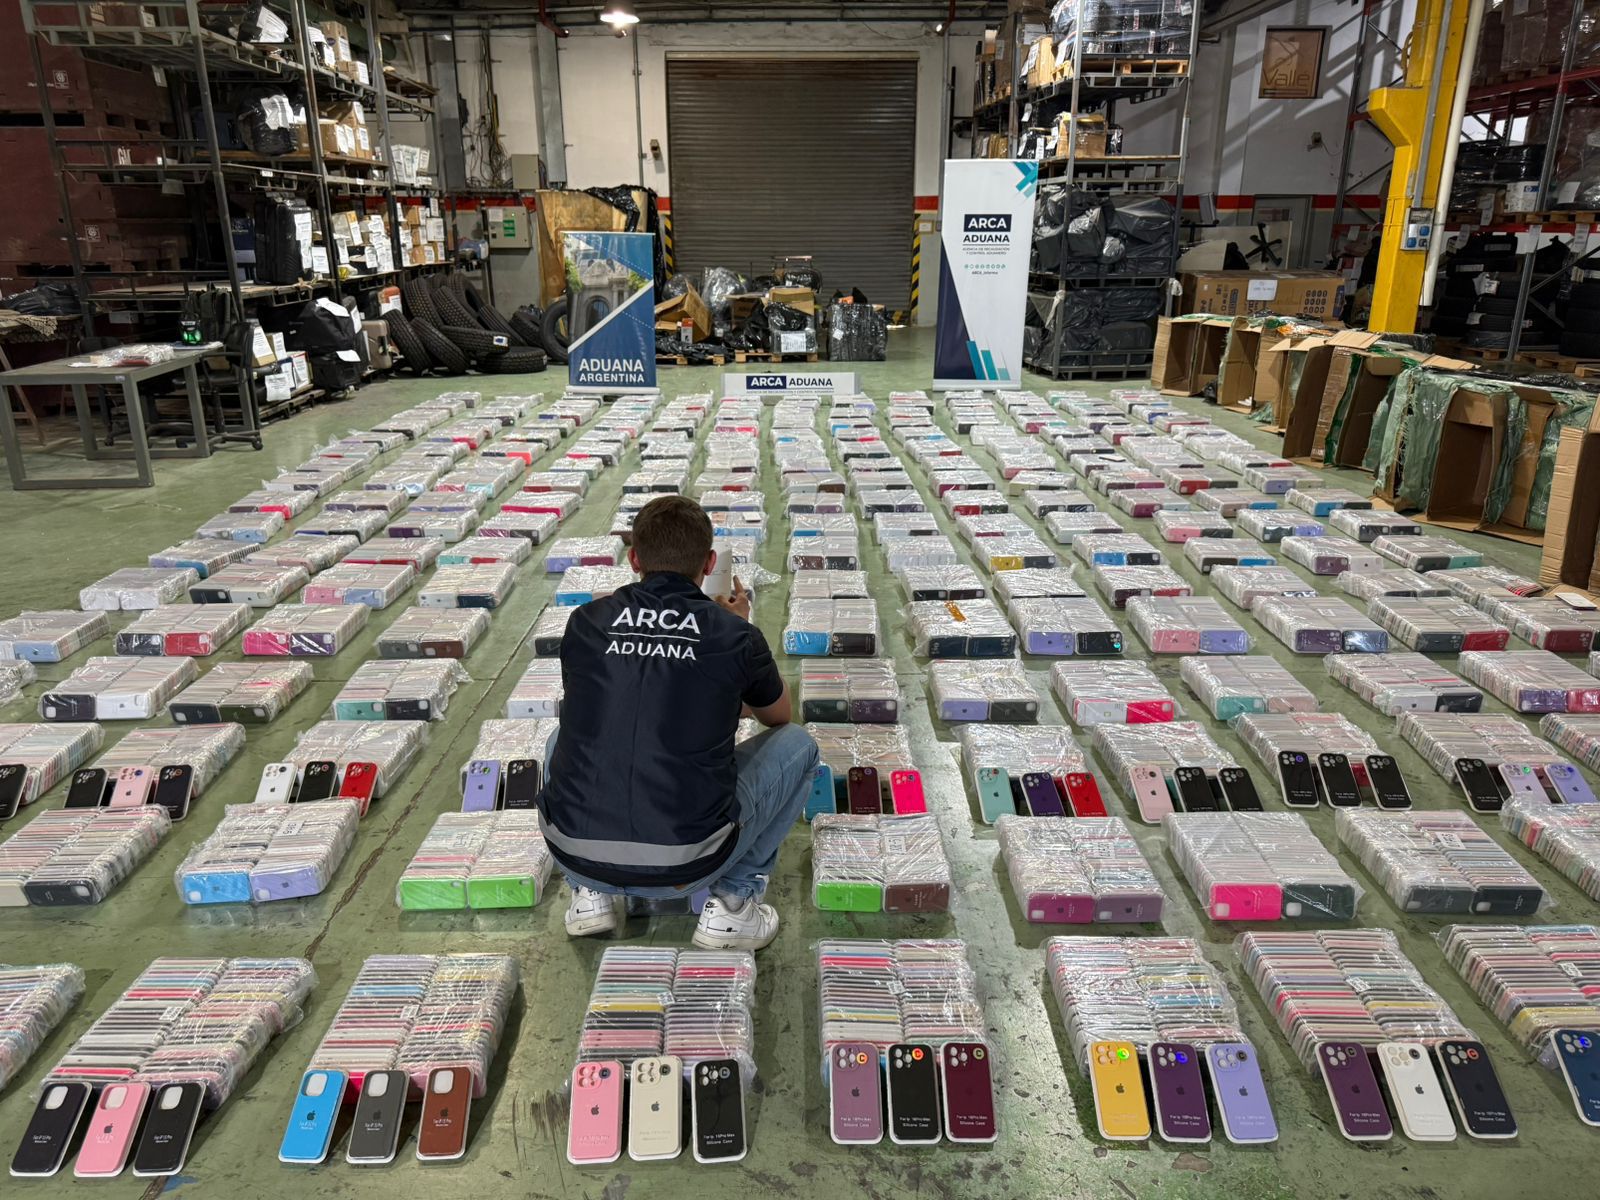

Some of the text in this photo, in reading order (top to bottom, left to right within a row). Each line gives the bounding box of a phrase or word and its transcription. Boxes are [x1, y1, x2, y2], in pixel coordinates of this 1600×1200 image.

[968, 217, 1007, 229] ARCA
[963, 234, 1010, 243] ADUANA
[579, 358, 645, 372] ADUANA
[579, 373, 645, 383] ARGENTINA
[750, 376, 833, 387] ARCA ADUANA
[611, 607, 701, 634] ARCA
[605, 640, 697, 661] ADUANA
